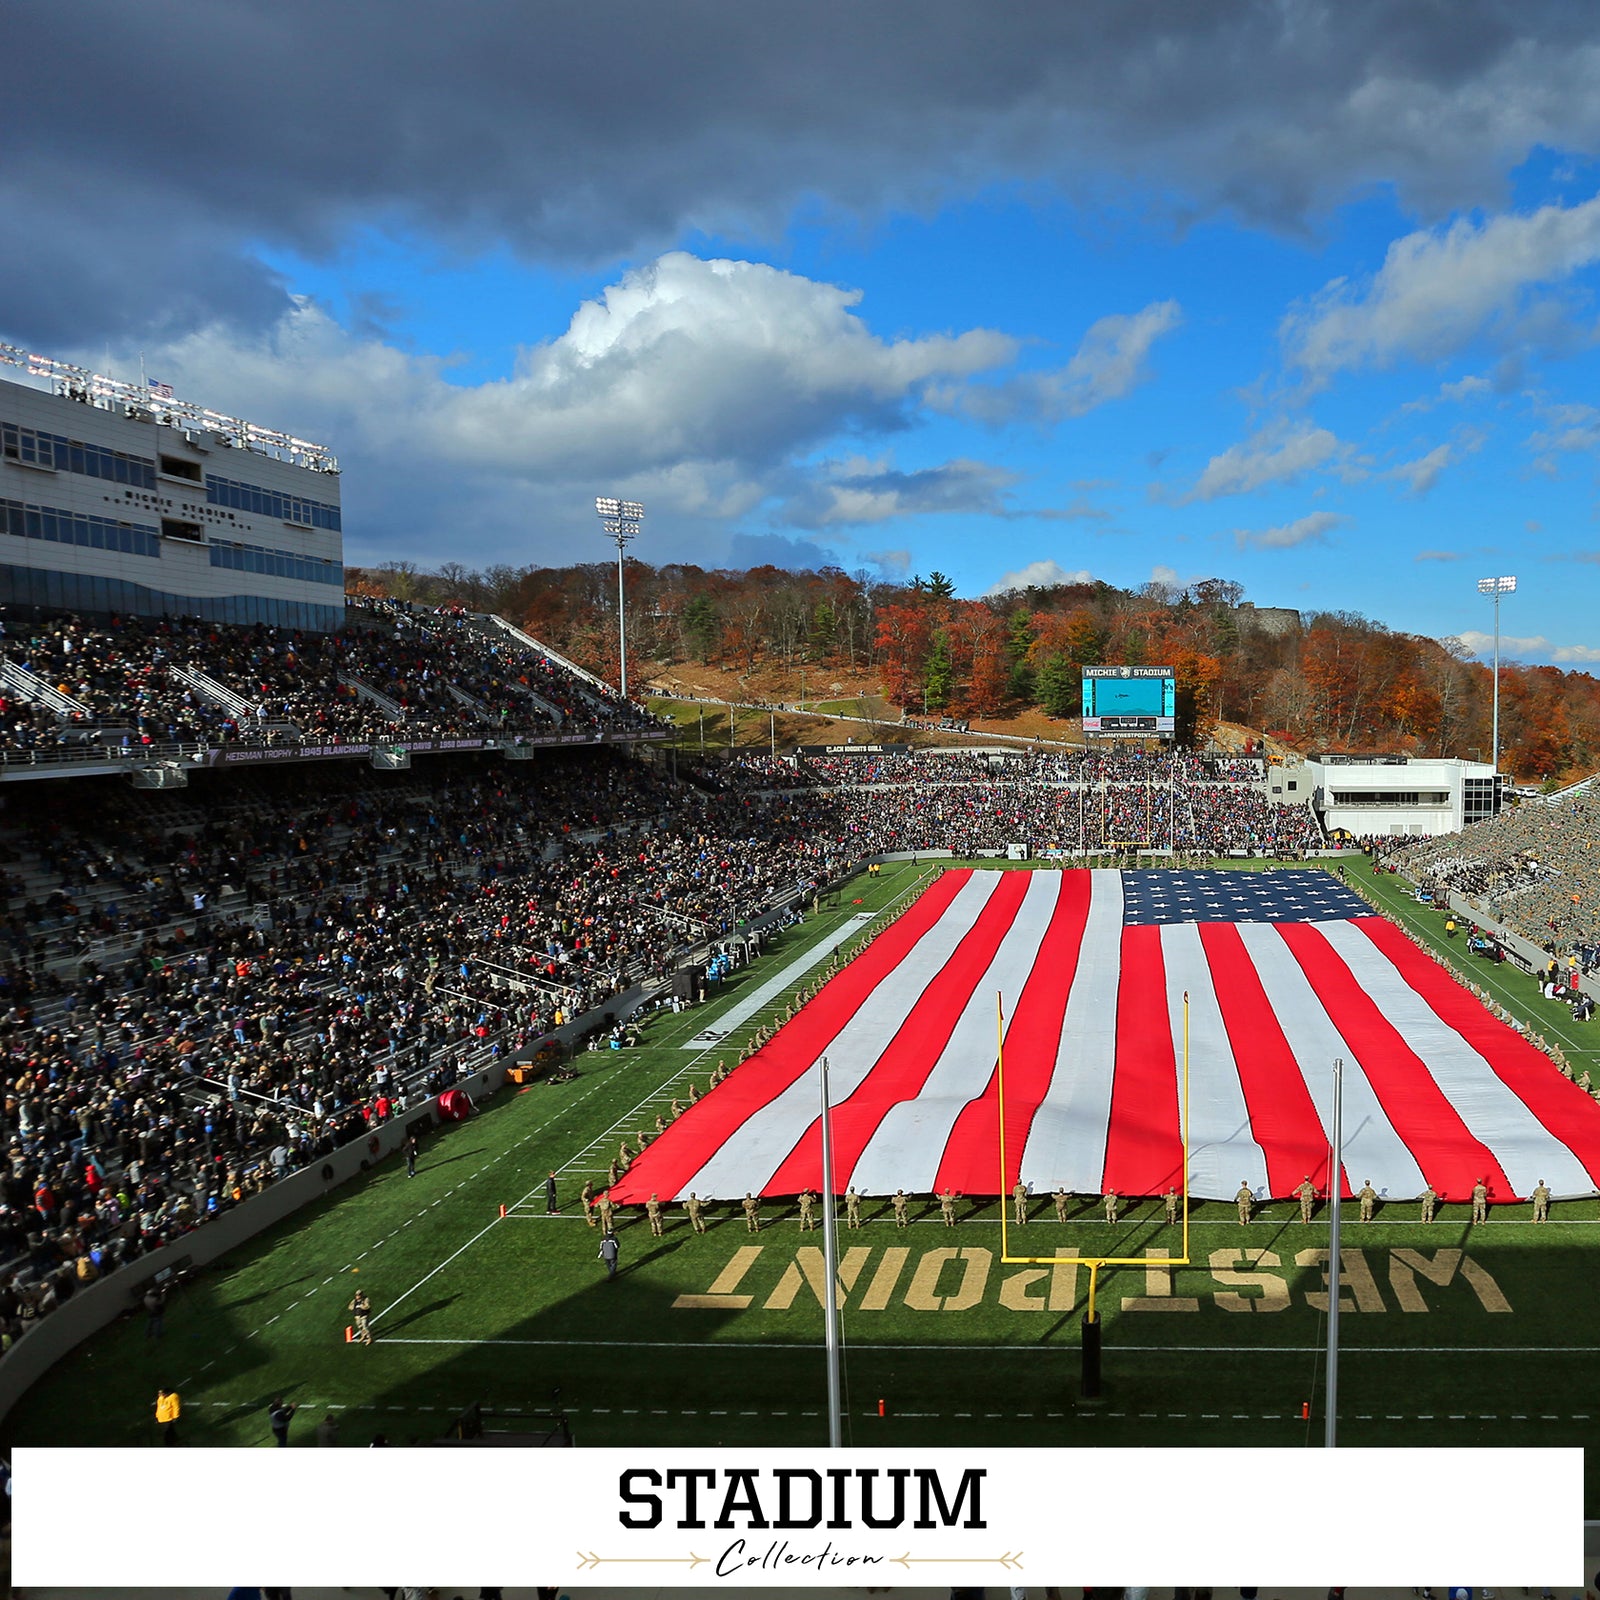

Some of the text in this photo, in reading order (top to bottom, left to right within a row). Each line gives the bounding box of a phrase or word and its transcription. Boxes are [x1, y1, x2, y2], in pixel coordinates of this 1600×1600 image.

[125, 491, 235, 520] MICHIE STADIUM
[225, 751, 262, 761] HEISMAN
[264, 749, 292, 759] TROPHY
[299, 747, 322, 756] 1945
[323, 744, 370, 755] BLANCHARD
[670, 1245, 1514, 1312] WEST POINT
